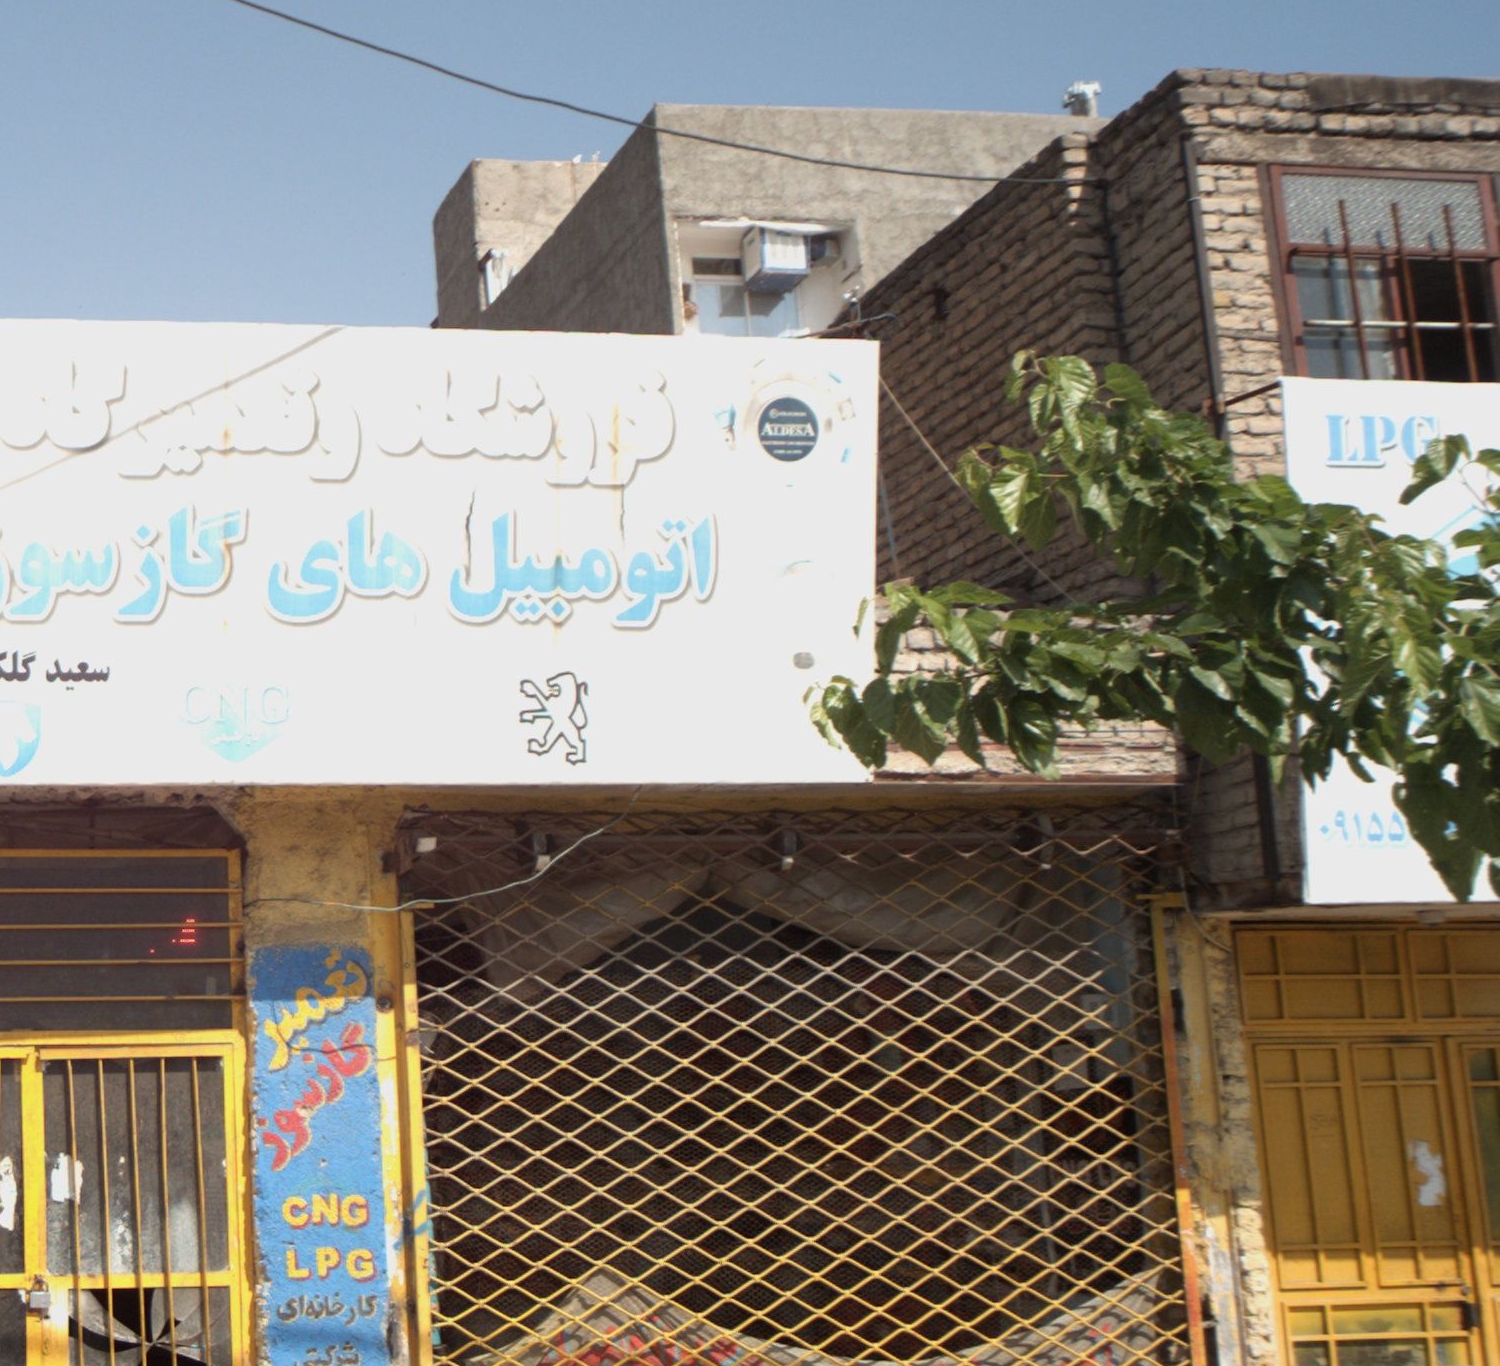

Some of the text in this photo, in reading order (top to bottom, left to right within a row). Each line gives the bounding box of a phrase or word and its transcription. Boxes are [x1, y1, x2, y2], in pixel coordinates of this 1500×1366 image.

[1325, 414, 1440, 467] LPG
[266, 507, 426, 624] های
[447, 511, 715, 629] اتومبیل
[45, 657, 111, 692] سعید
[281, 1193, 370, 1230] CNG
[285, 1246, 377, 1283] LPG
